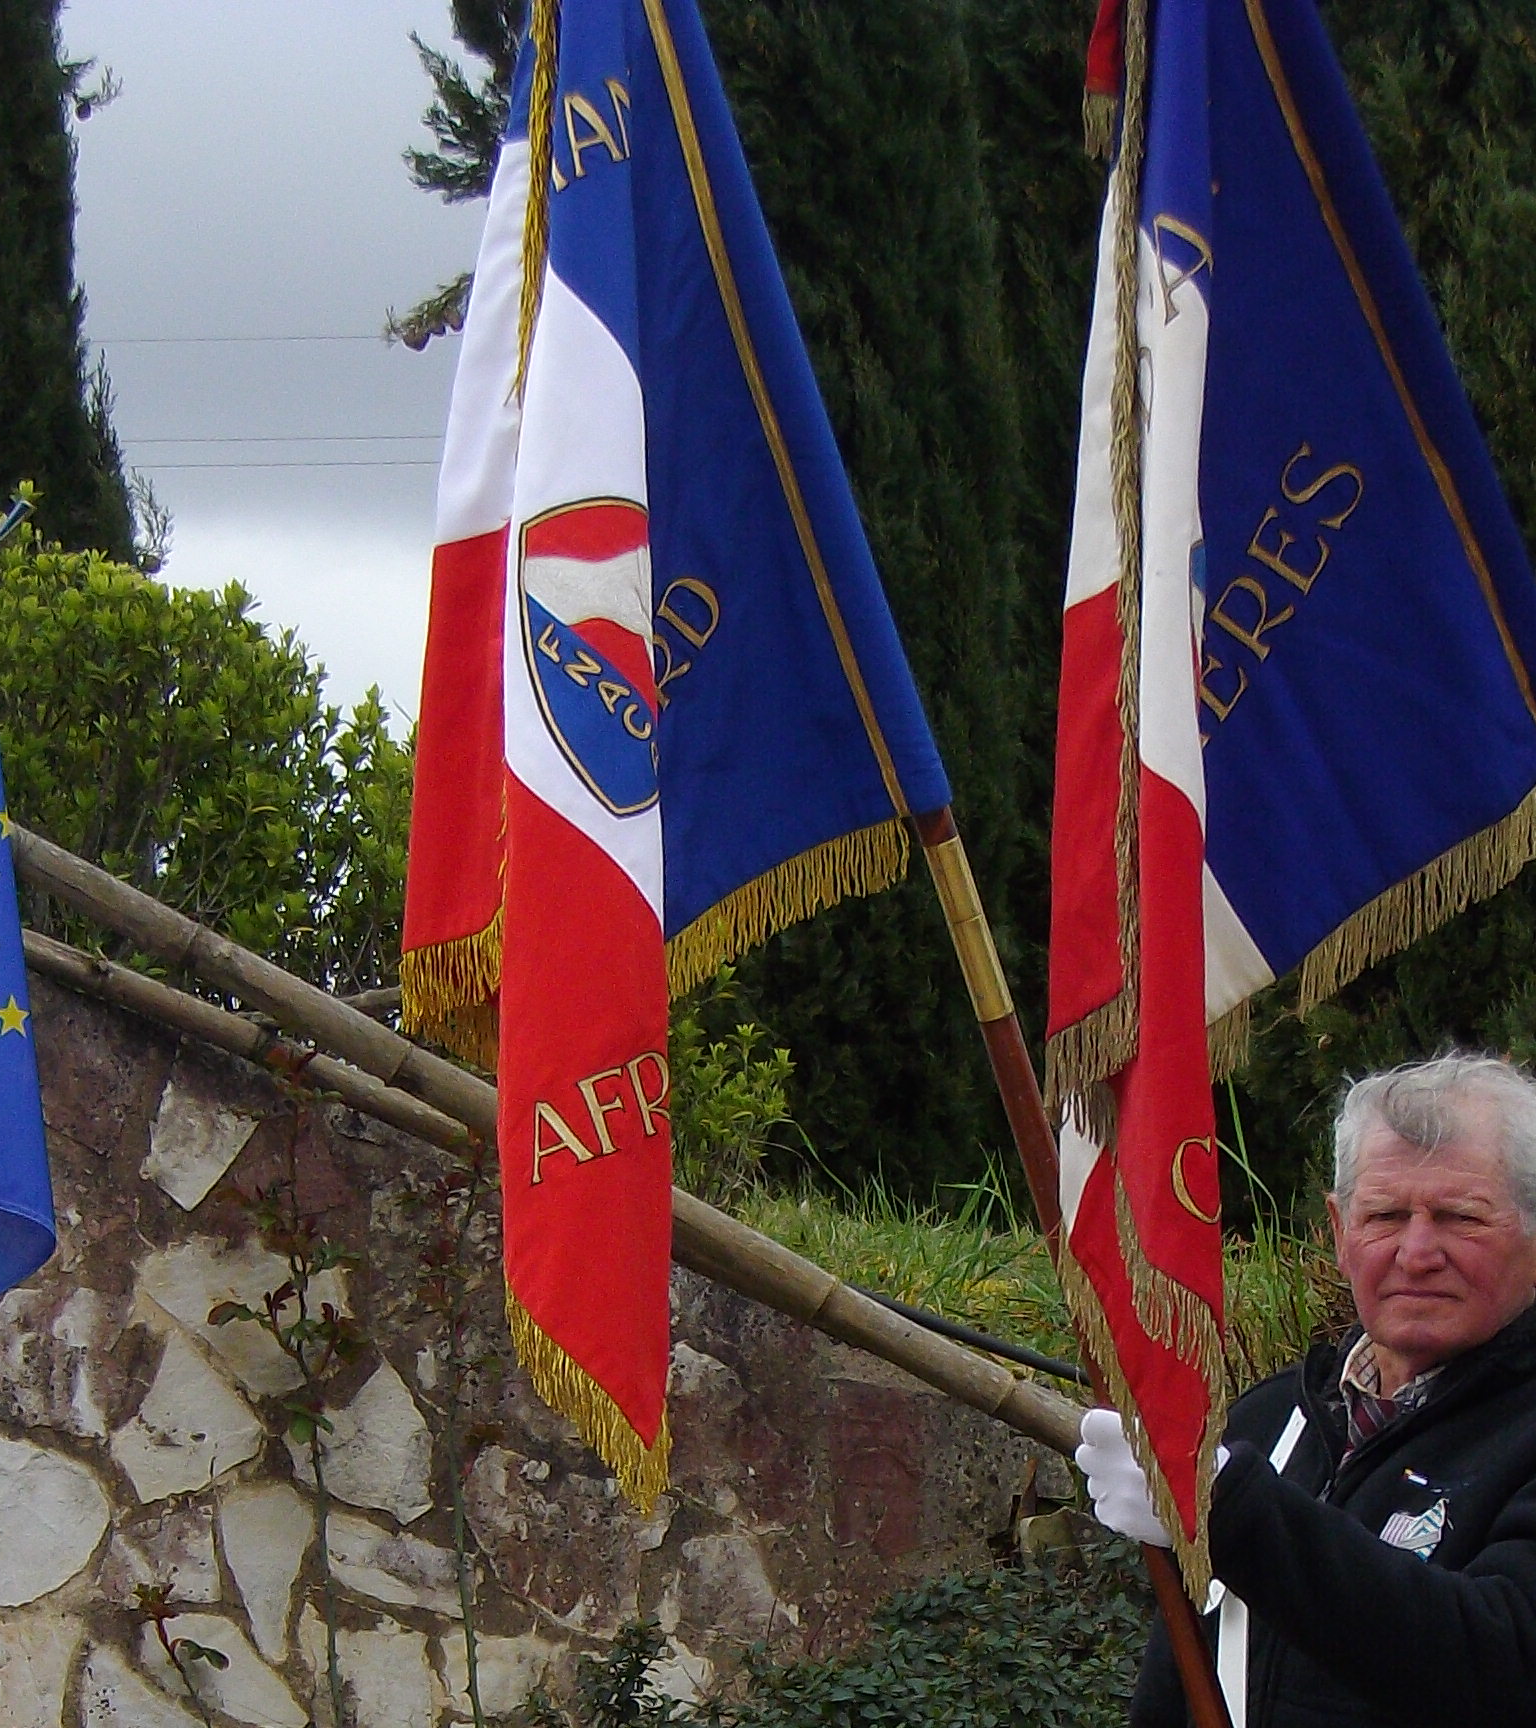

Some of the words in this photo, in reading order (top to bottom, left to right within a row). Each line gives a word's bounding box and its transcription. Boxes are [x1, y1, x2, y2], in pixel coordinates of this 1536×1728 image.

[1200, 441, 1364, 750] ERES
[537, 622, 660, 777] FNAC
[530, 1051, 671, 1186] AFR
